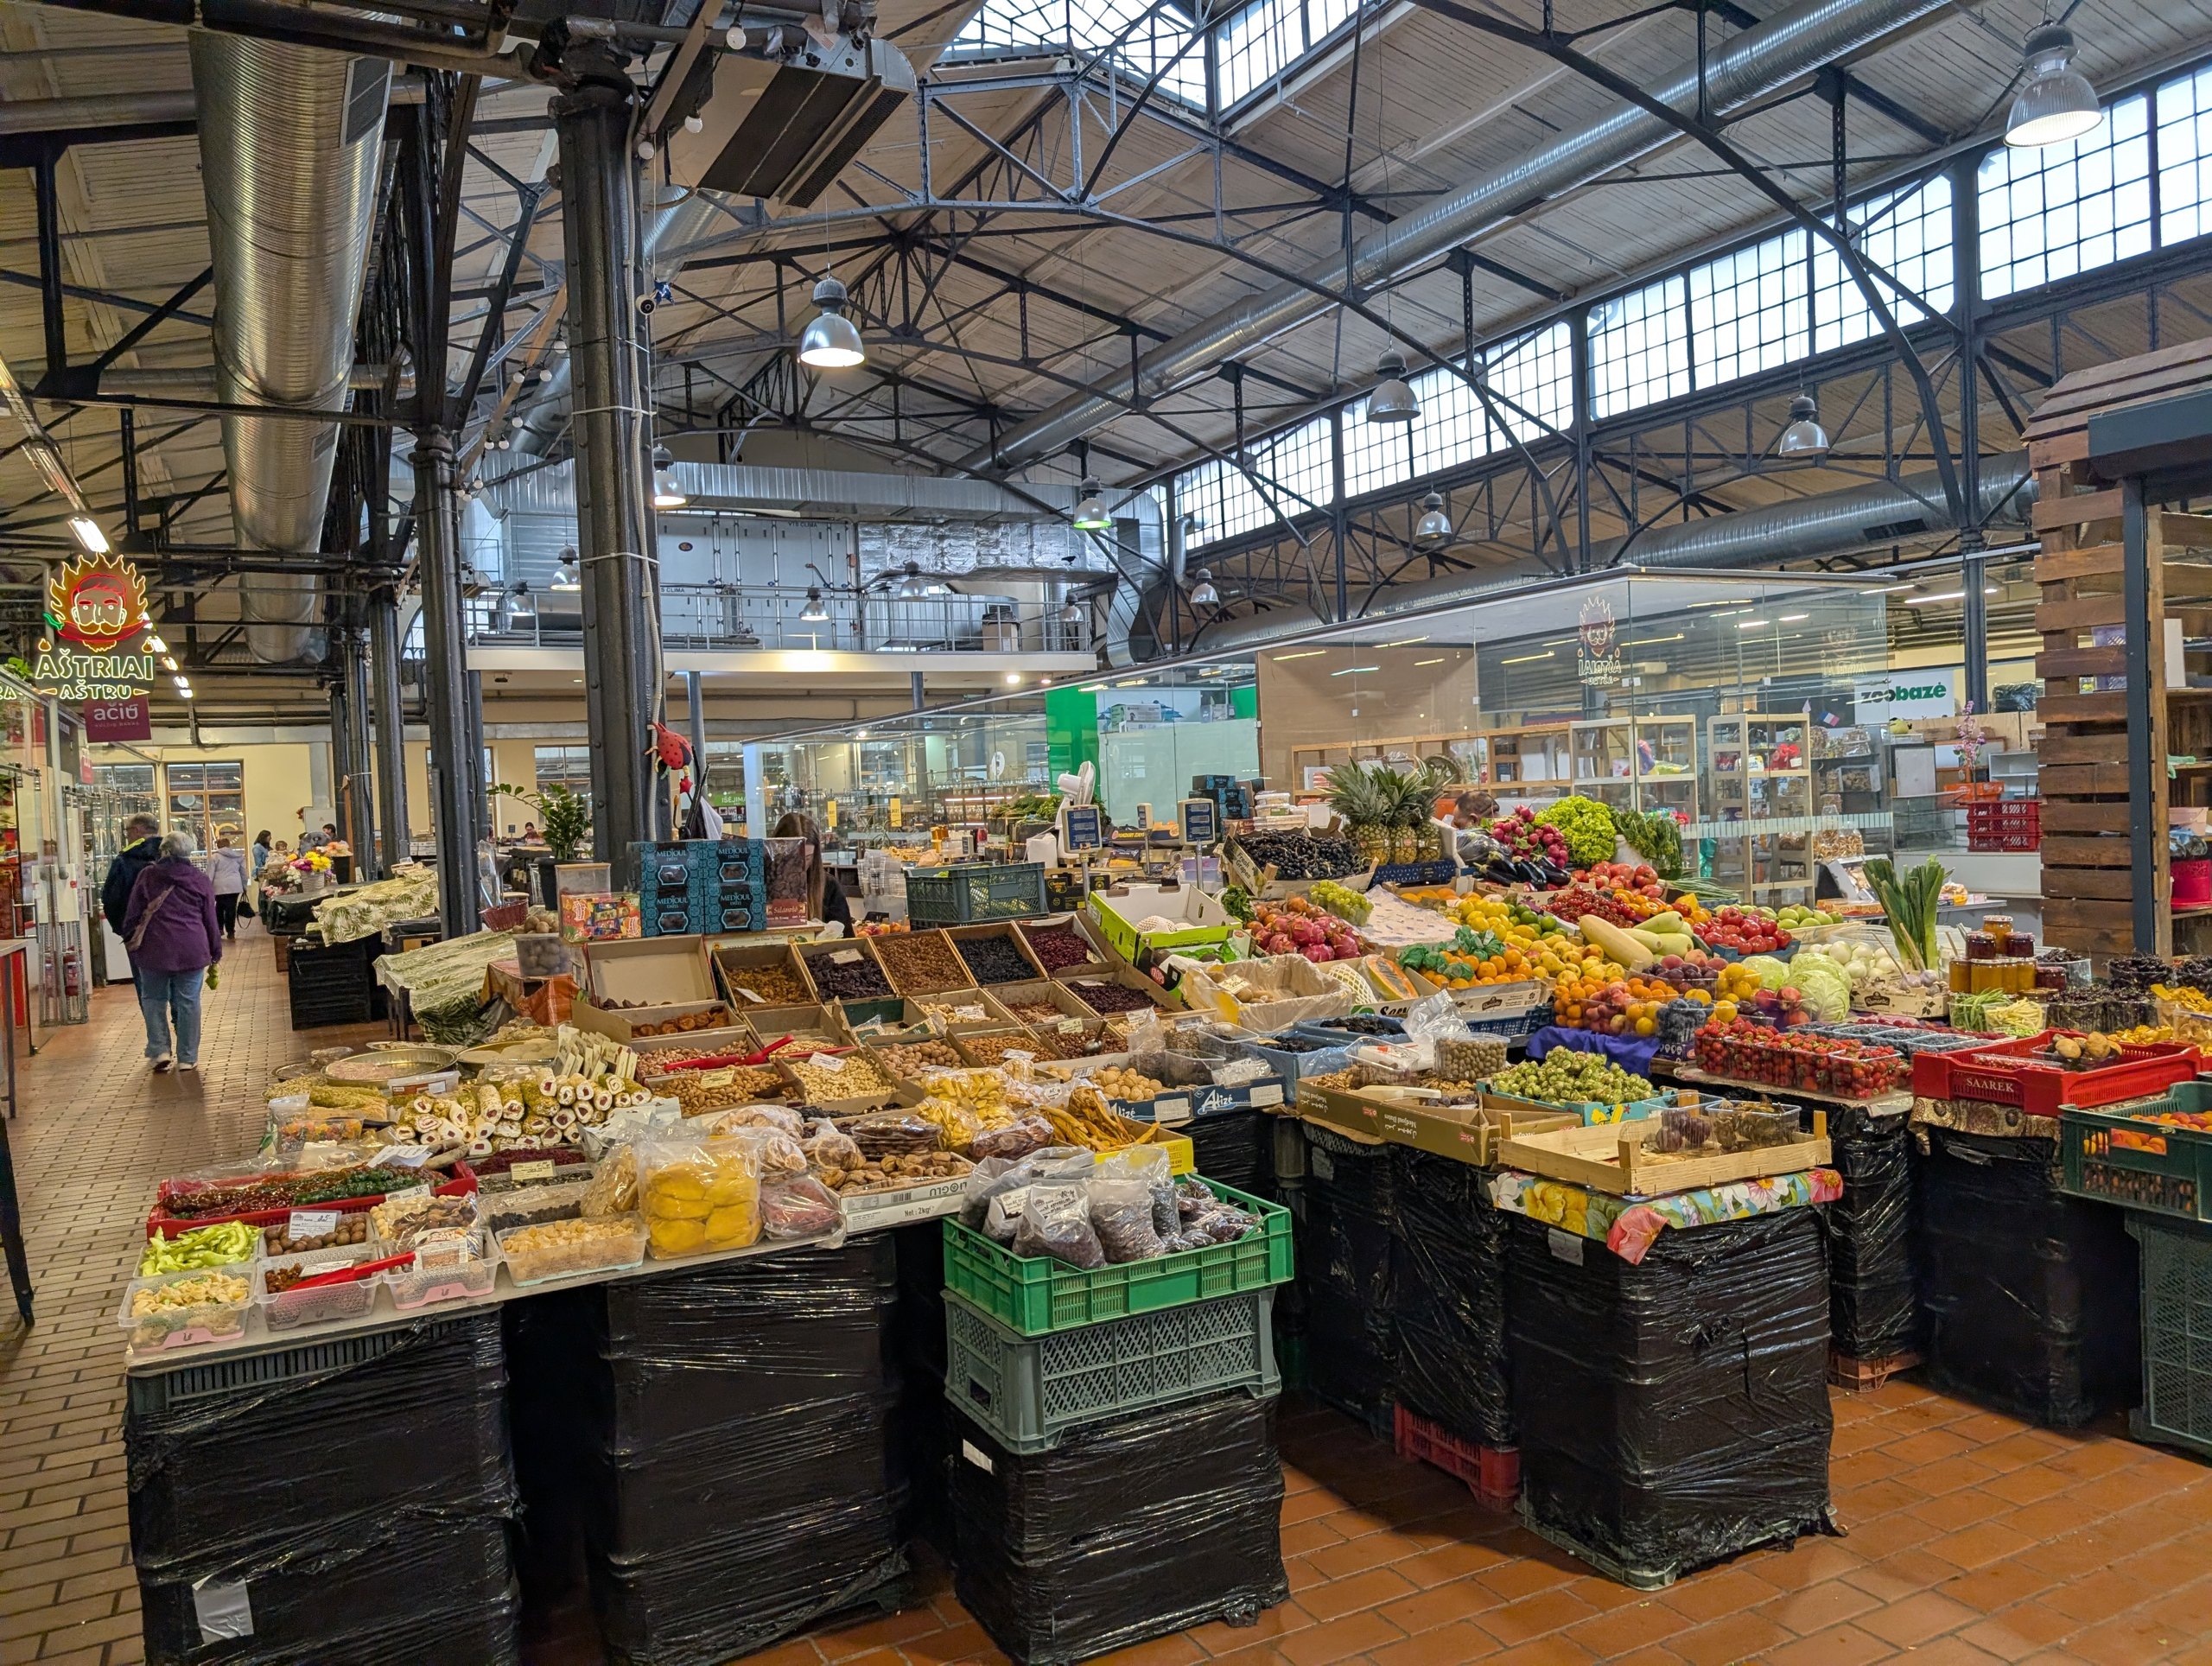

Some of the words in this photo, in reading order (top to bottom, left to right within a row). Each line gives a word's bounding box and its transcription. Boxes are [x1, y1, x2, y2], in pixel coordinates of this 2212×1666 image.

[35, 648, 154, 681] AŠTRIAI
[60, 679, 131, 700] AŠTRU
[1860, 682, 1947, 704] zoobazė
[656, 848, 686, 857] MEDJOUL
[718, 847, 749, 855] MEDJOUL
[1236, 852, 1250, 868] Fresh
[1236, 860, 1251, 880] Grapes
[657, 895, 689, 905] MEDJOUL
[720, 893, 751, 902] MEDJOUL
[1966, 1077, 2015, 1093] SAAREK
[1202, 1089, 1233, 1111] Alizé
